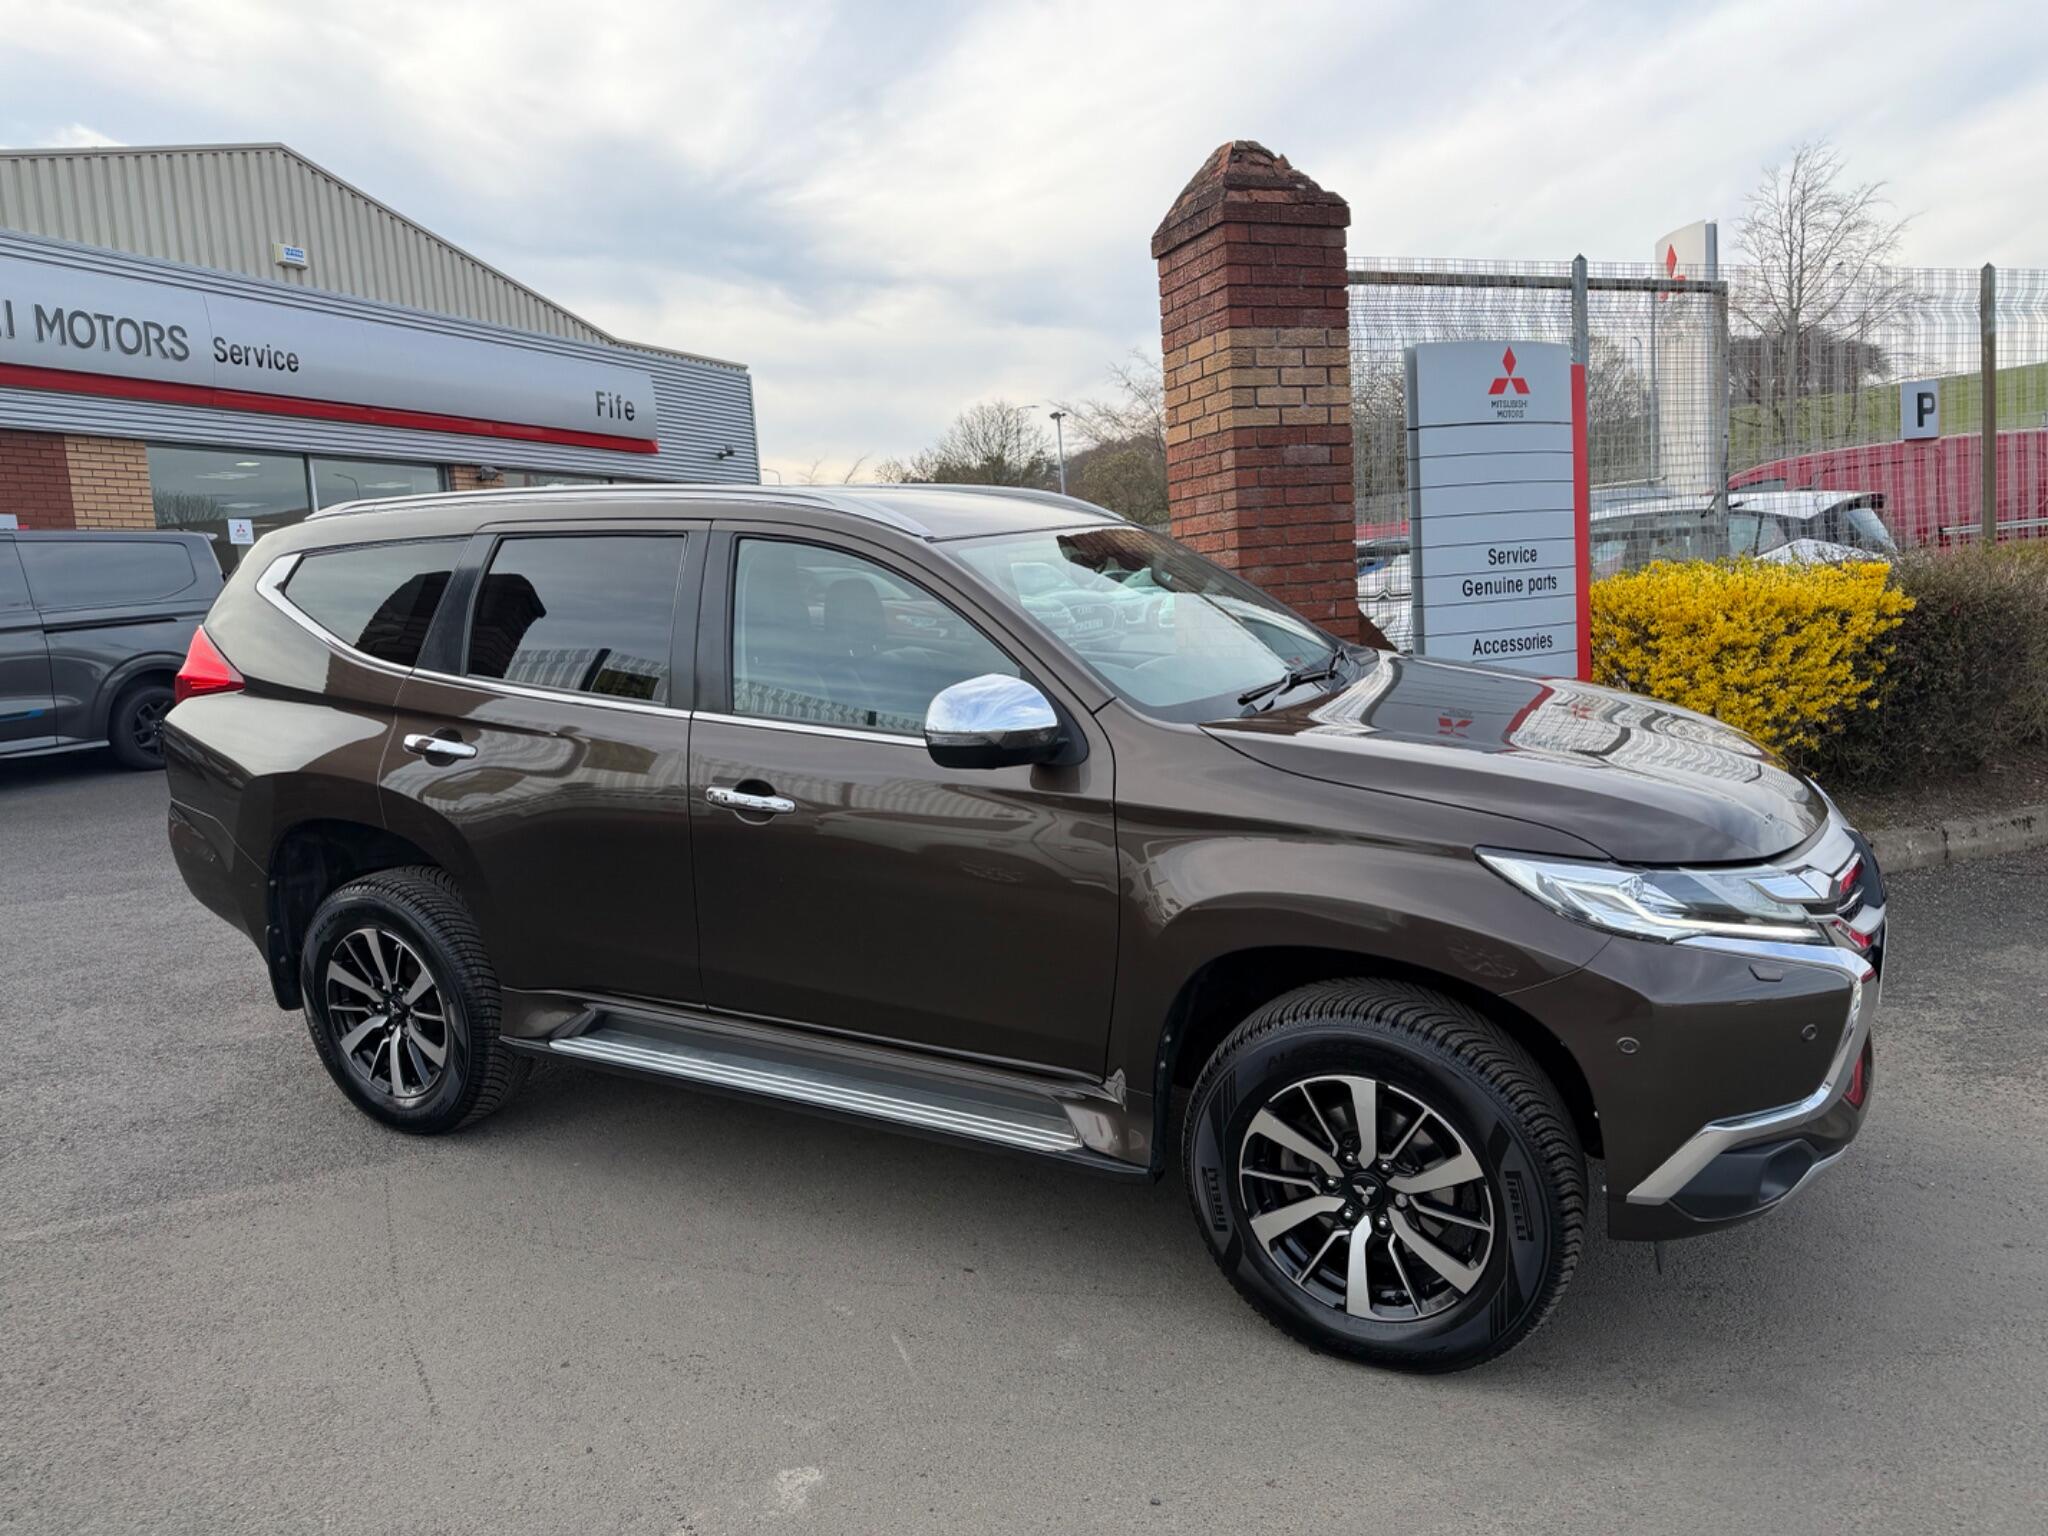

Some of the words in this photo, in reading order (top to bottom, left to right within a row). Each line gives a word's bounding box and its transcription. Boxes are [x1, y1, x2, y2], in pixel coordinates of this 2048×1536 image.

[34, 303, 190, 362] MOTORS
[213, 336, 299, 373] Service
[595, 391, 635, 421] Fife
[1917, 392, 1936, 428] P
[1488, 546, 1537, 565] Service
[1462, 576, 1523, 597] Genuine
[1528, 574, 1557, 595] parts
[1472, 633, 1553, 656] Accessories
[1202, 1167, 1228, 1232] PIRELLI
[1504, 1170, 1535, 1242] PIRELLI
